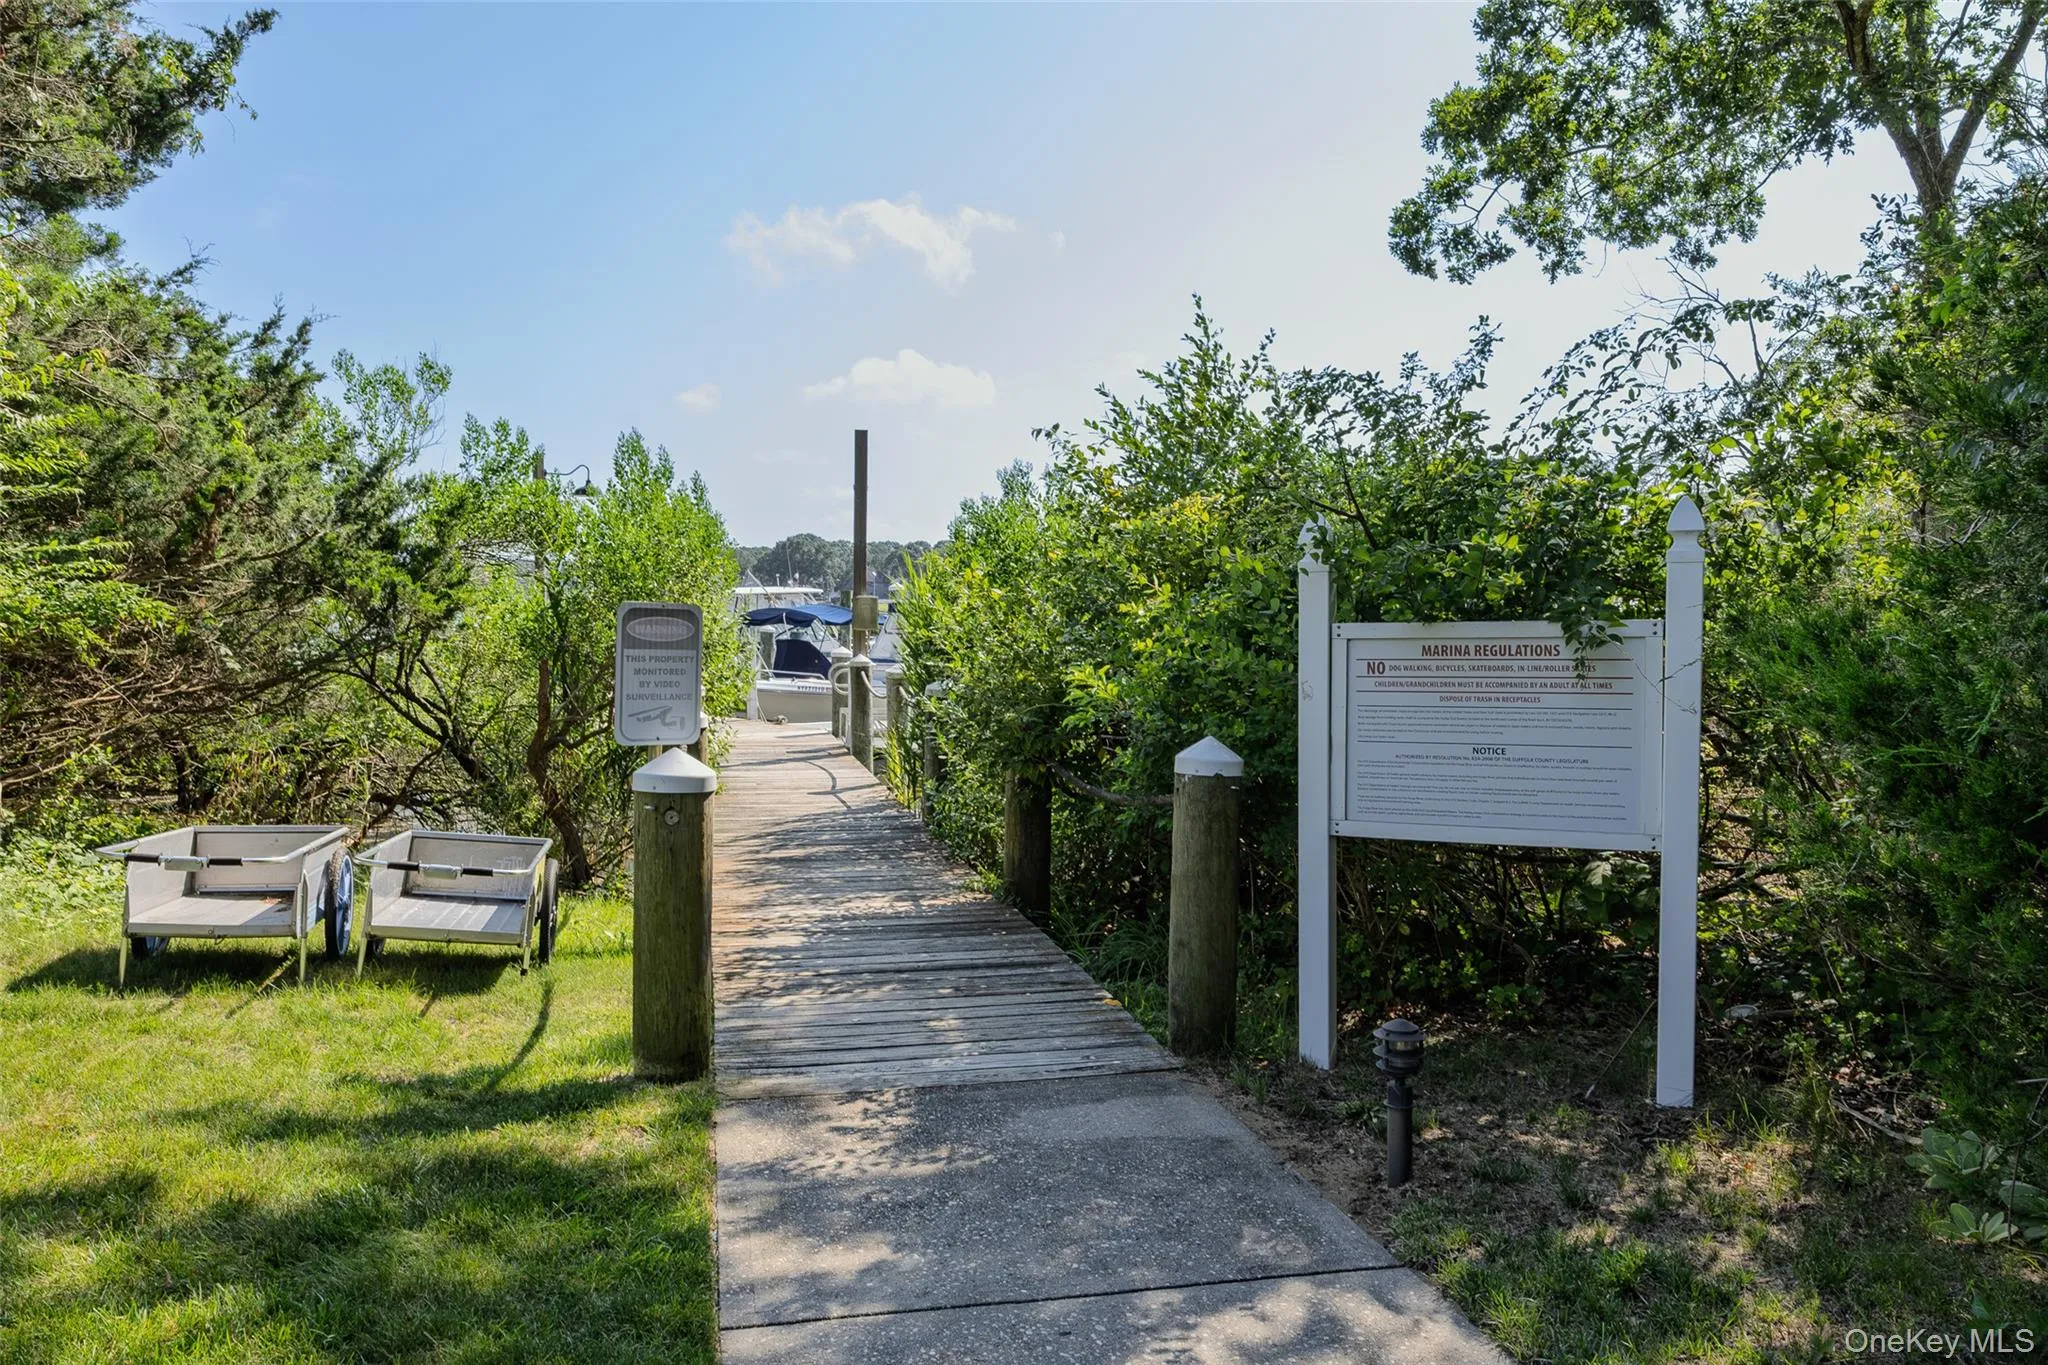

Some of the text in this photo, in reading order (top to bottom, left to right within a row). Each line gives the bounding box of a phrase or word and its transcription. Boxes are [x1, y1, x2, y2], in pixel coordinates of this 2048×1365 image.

[1421, 644, 1561, 657] MARINA REGULATIONS
[625, 655, 695, 664] THIS PROPERTY
[633, 668, 687, 676] MONITORED
[1366, 661, 1386, 675] NO
[1388, 664, 1402, 672] DOG
[1403, 664, 1434, 673] WALKING,
[1435, 664, 1467, 673] BICYCLES,
[1468, 664, 1516, 673] SKATEBOARDS,
[639, 680, 681, 688] BY VIDEO
[1374, 680, 1457, 688] CHILDREN/GRANDCHILDREN
[1457, 681, 1474, 689] MUST
[1475, 681, 1483, 689] BE
[1484, 681, 1529, 689] ACCOMPANIED
[1530, 681, 1539, 689] BY
[1539, 681, 1548, 689] AN
[1549, 681, 1570, 689] ADULT
[1571, 681, 1578, 689] AT
[1592, 681, 1613, 690] TIMES
[625, 692, 692, 701] SURVEILLANCE
[1439, 695, 1464, 703] DISPOSE
[1464, 695, 1472, 703] OF
[1473, 695, 1493, 703] TRASH
[1501, 696, 1541, 704] RECEPTACLES
[1472, 747, 1506, 756] NOTICE
